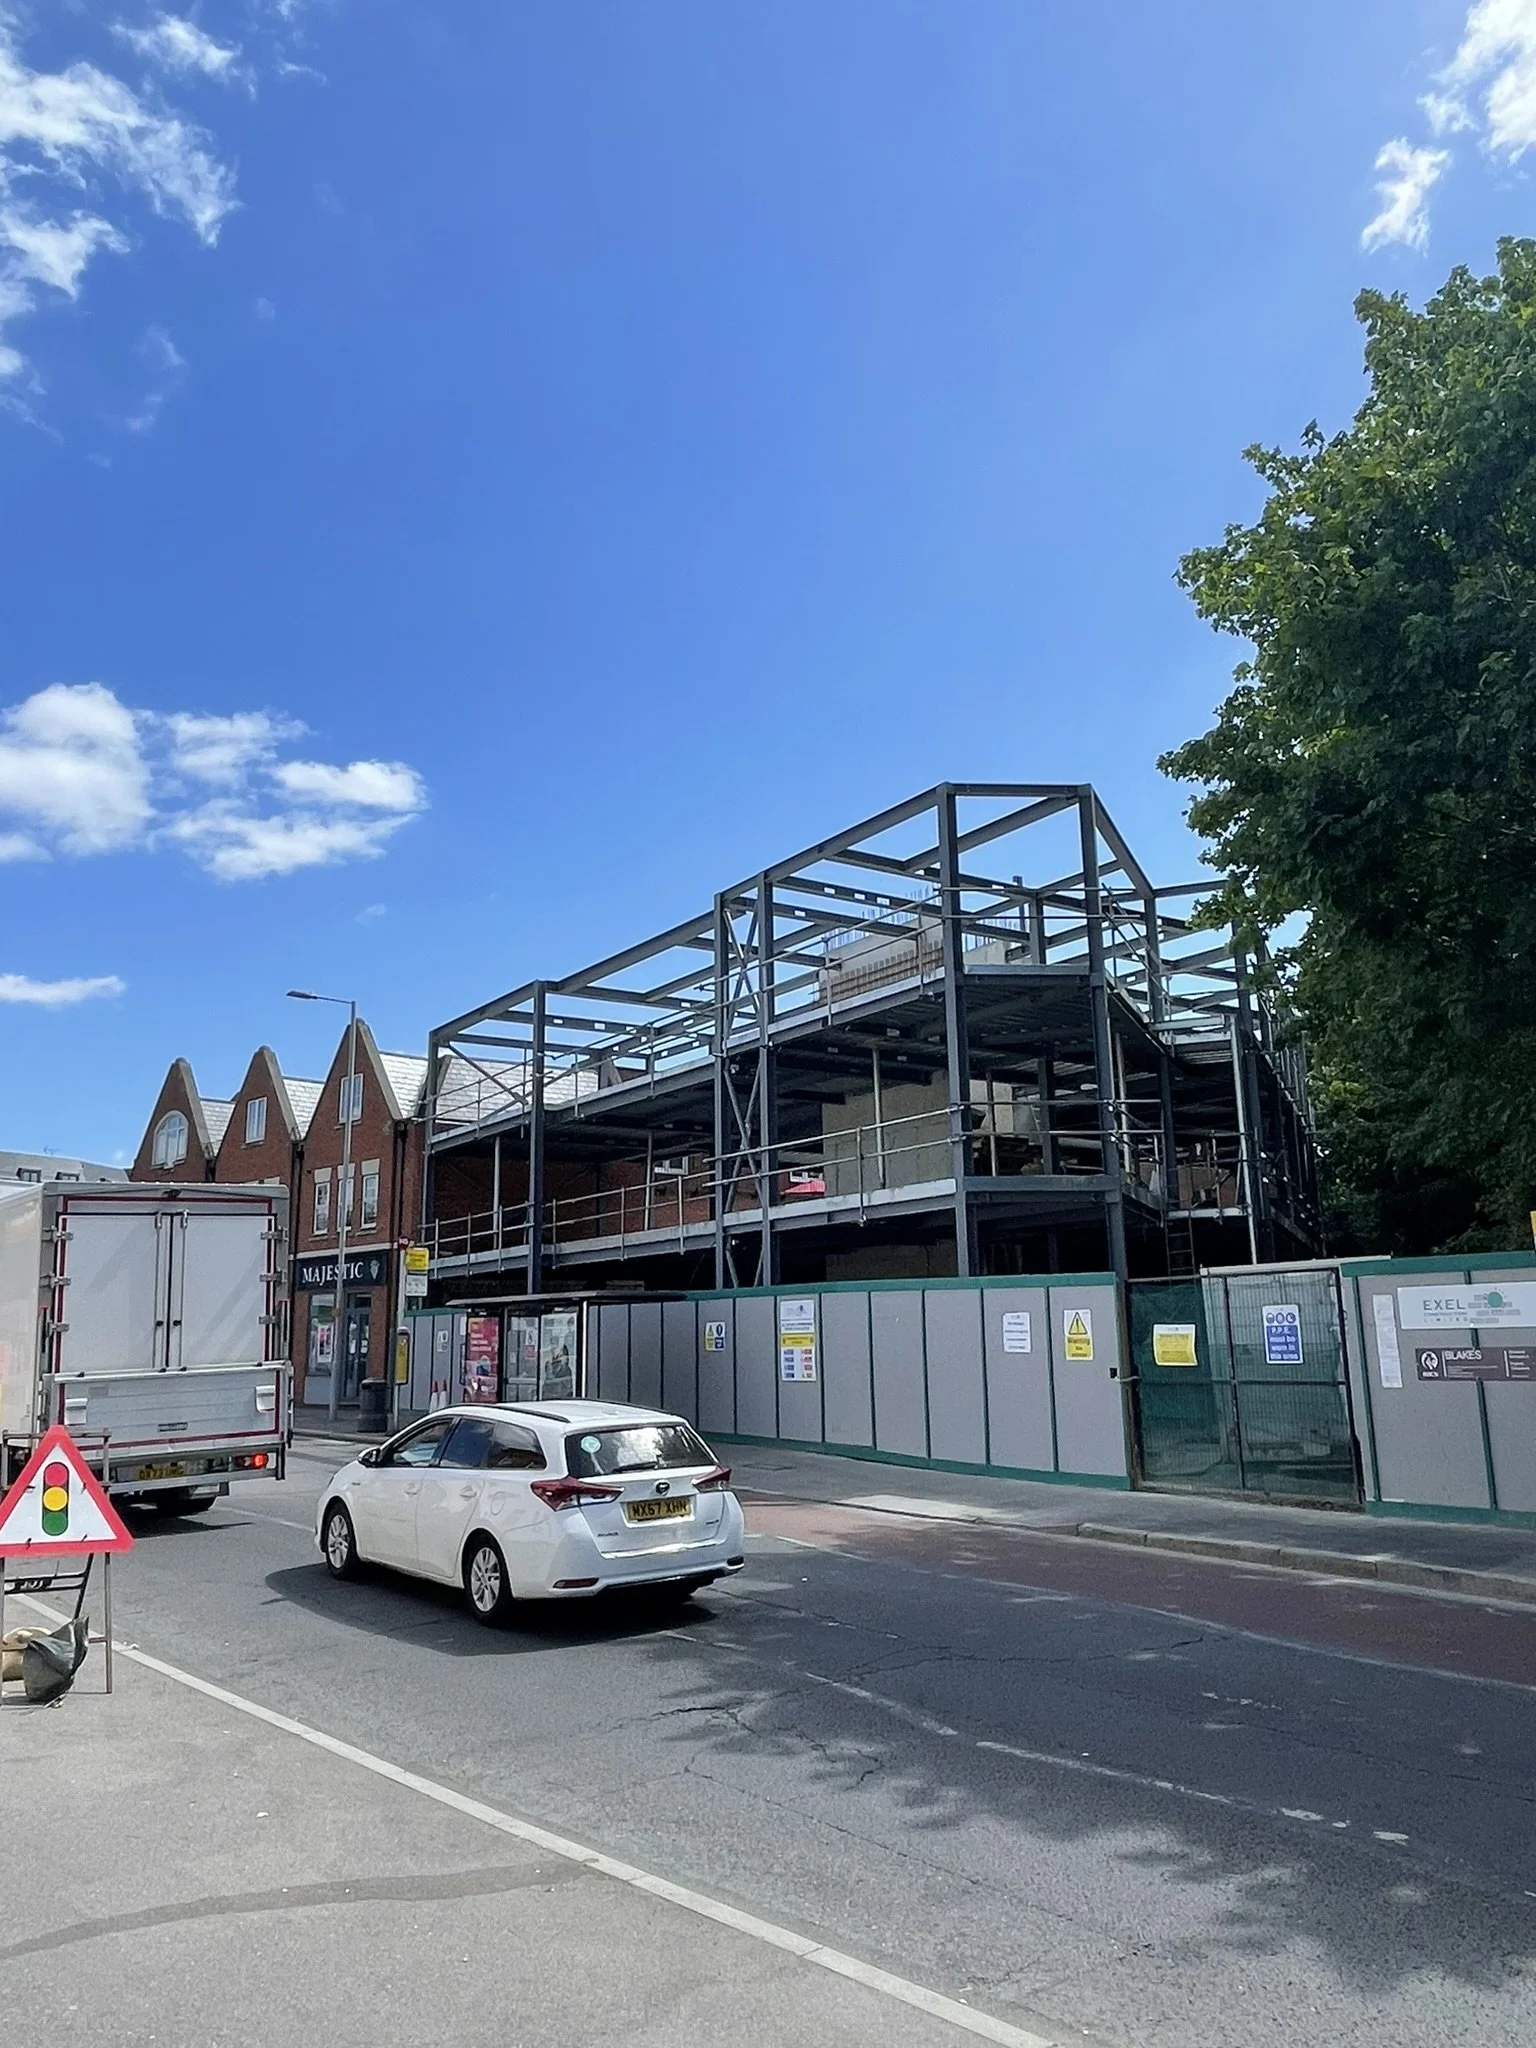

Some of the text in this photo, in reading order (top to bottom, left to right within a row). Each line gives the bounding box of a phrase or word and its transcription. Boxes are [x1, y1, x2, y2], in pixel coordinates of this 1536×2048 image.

[302, 1262, 364, 1286] MAJESTIC
[1423, 1299, 1466, 1310] EXEL
[1444, 1350, 1482, 1360] BLAKES
